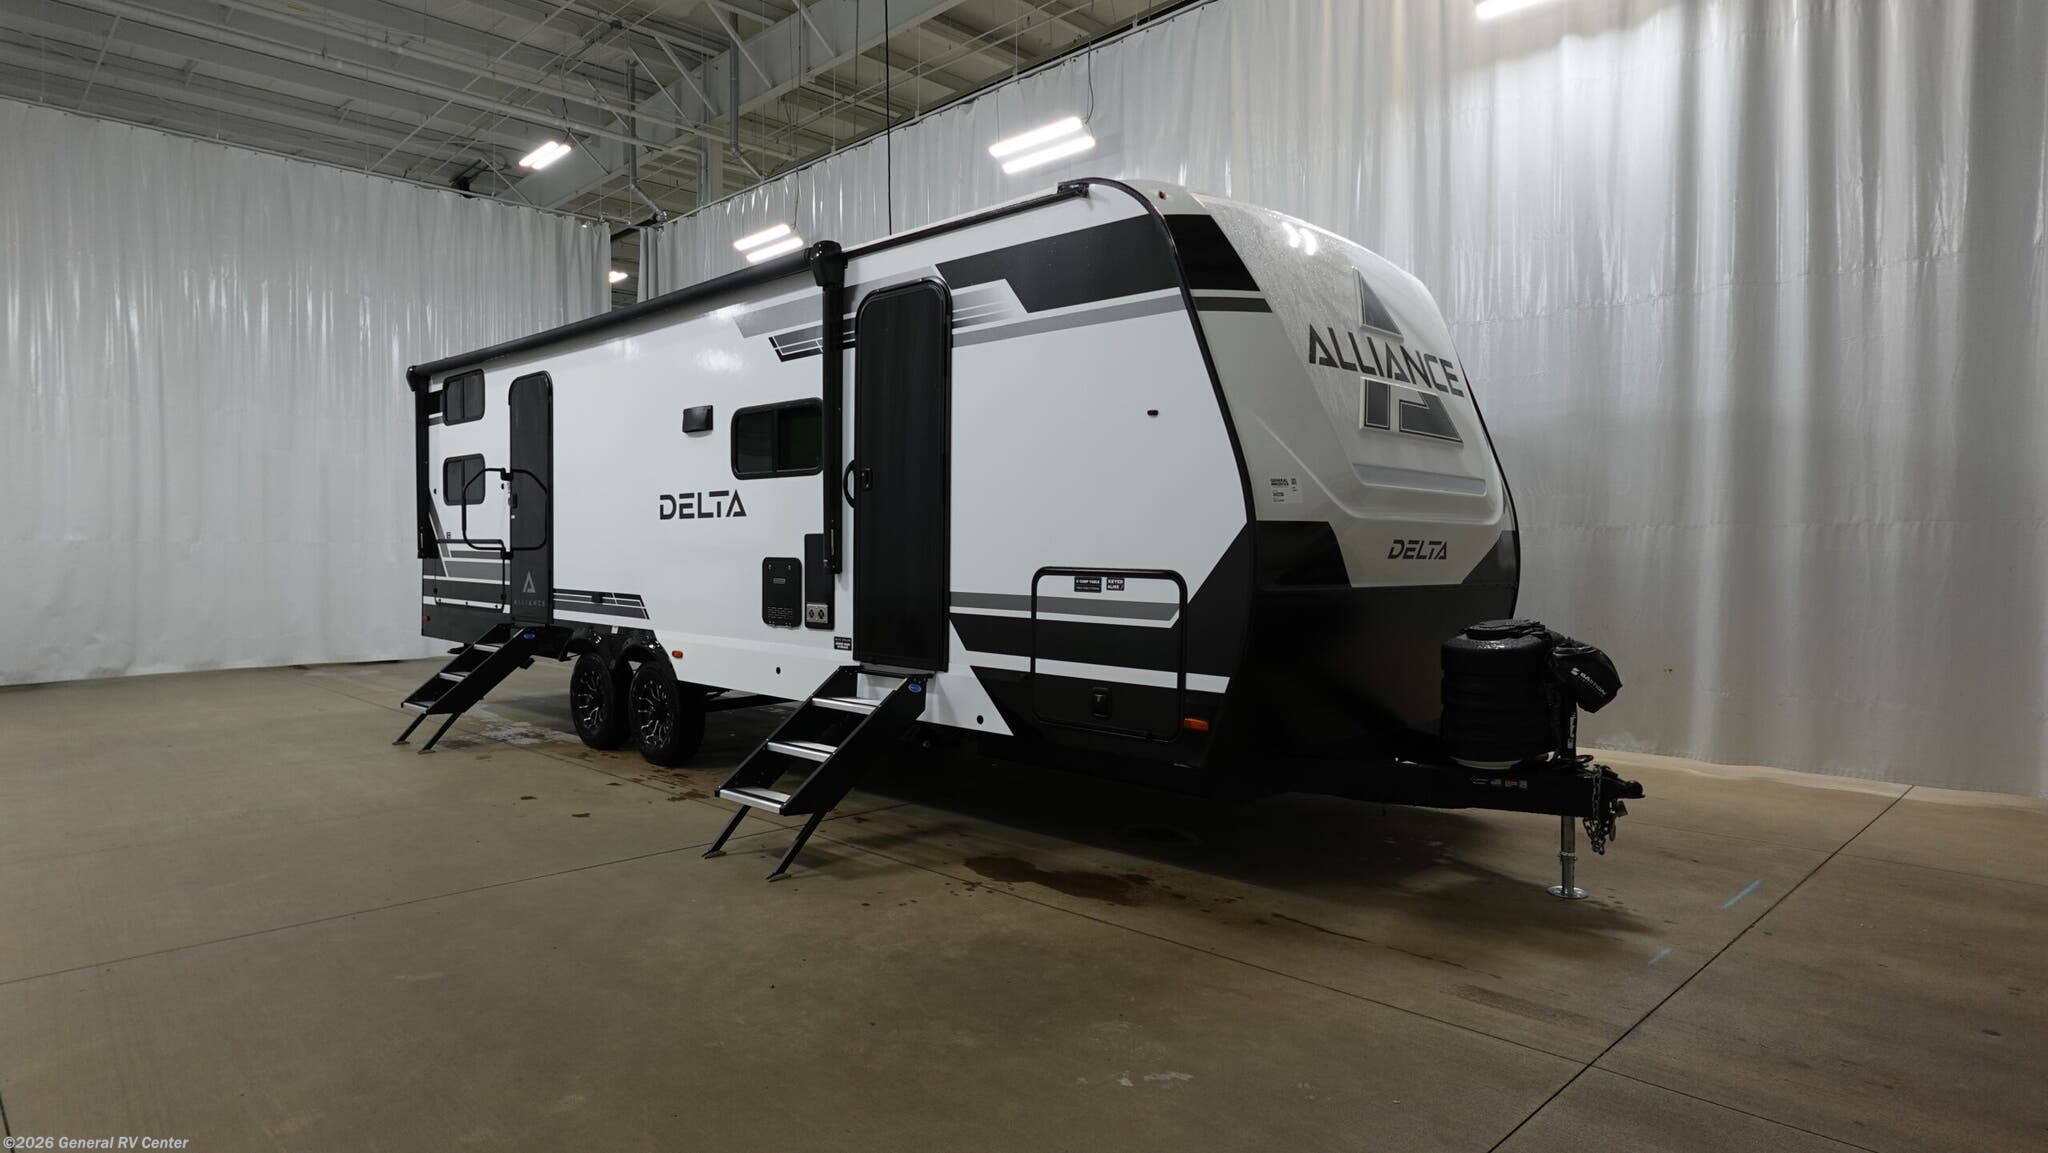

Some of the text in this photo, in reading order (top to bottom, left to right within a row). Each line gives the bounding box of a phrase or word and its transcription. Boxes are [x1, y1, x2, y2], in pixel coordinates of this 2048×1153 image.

[1309, 323, 1464, 398] ALLIANCE
[659, 489, 747, 520] DELTA
[1388, 539, 1448, 560] DELTA
[513, 599, 546, 608] ALLIANCE
